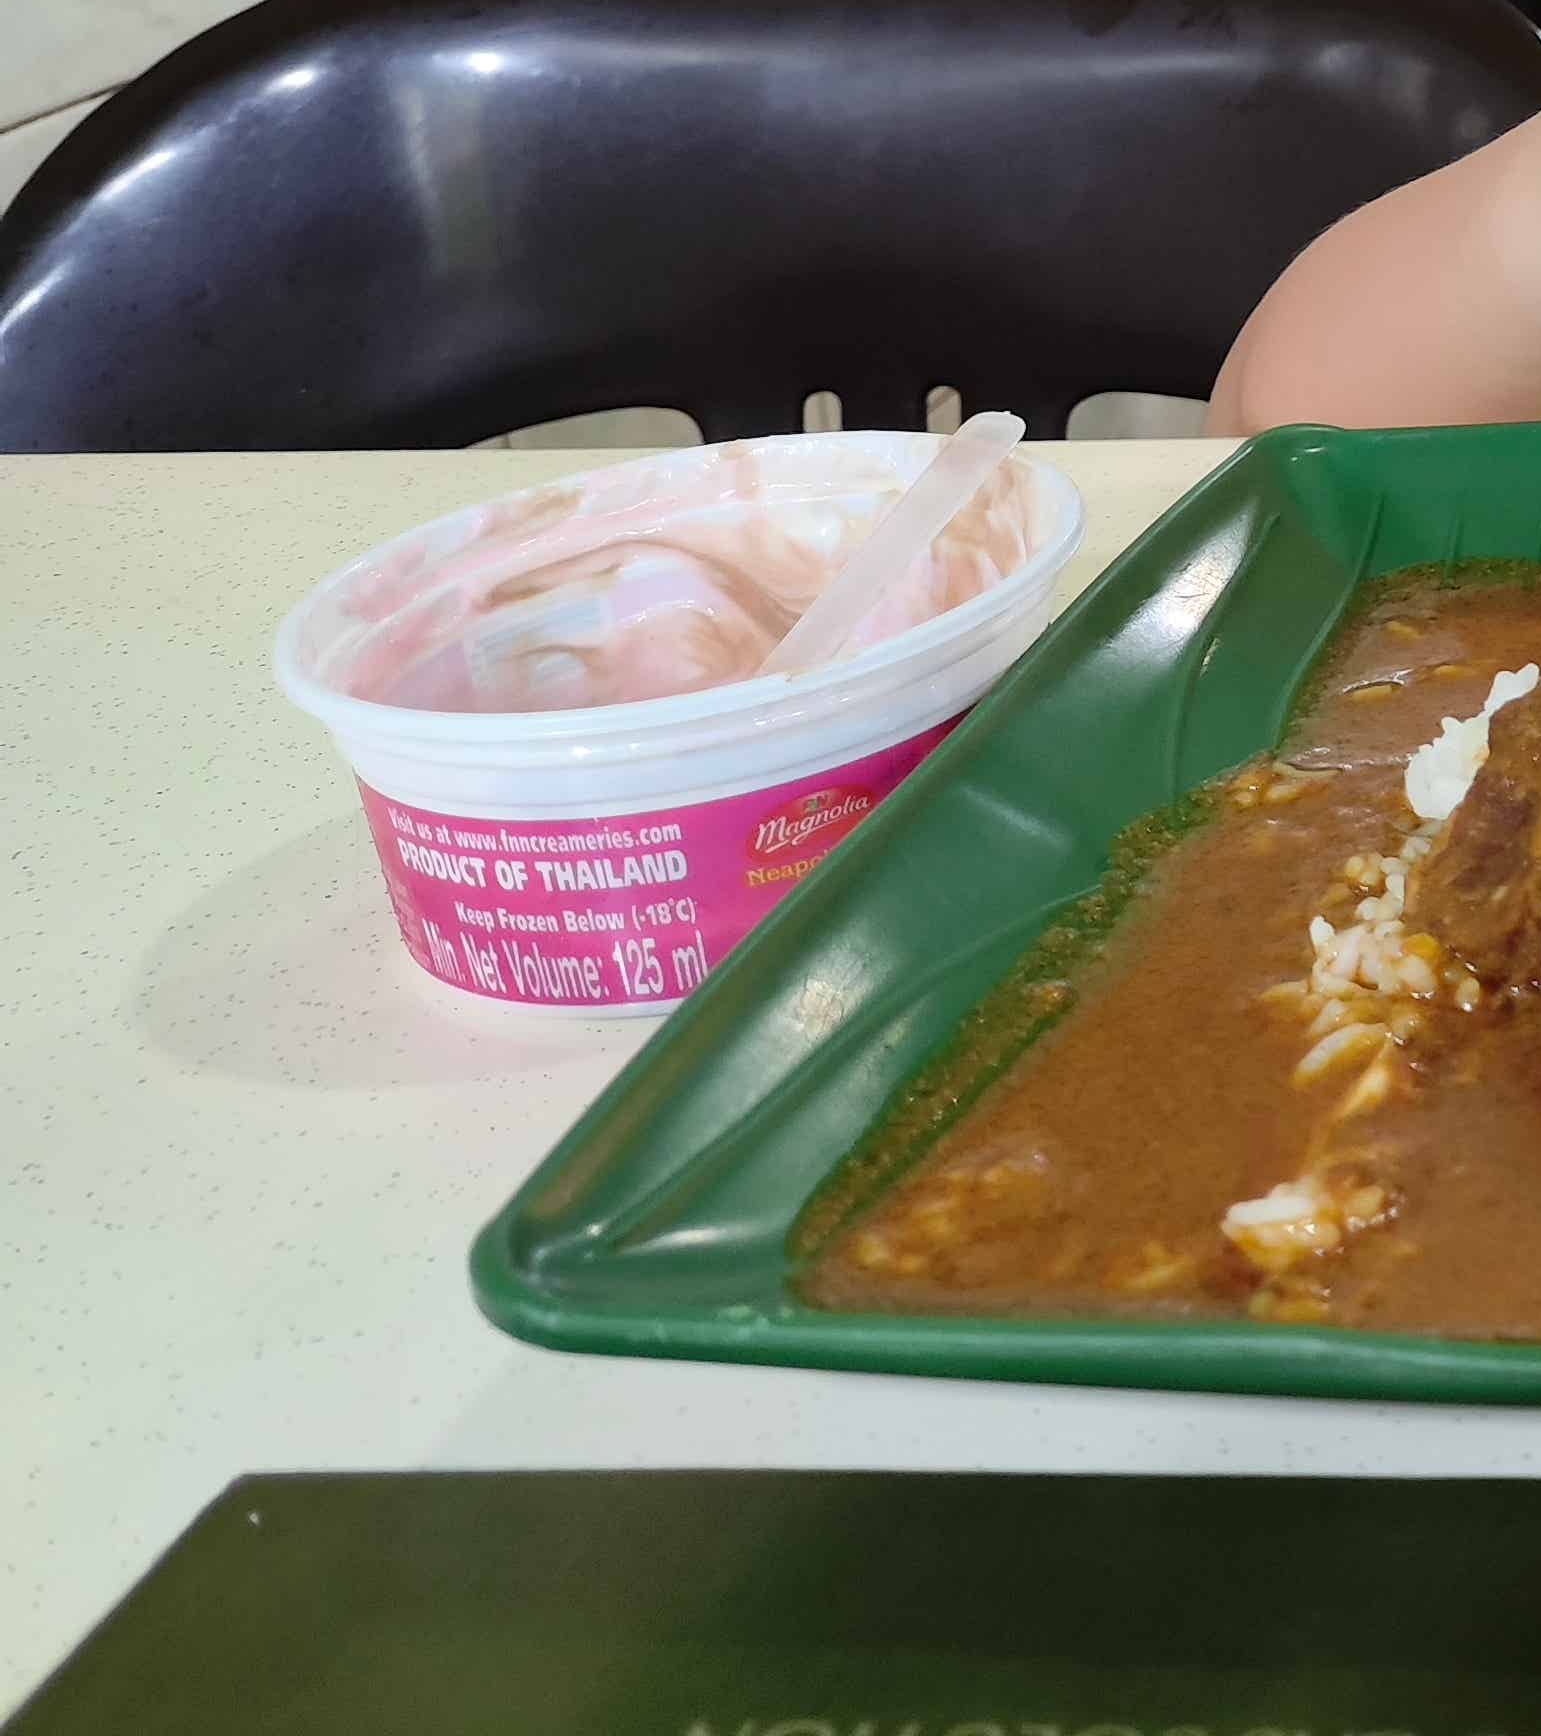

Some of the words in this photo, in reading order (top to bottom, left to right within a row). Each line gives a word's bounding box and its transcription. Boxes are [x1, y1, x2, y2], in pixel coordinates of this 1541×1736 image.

[388, 807, 416, 836] Visit
[416, 822, 433, 841] us
[436, 824, 452, 845] at
[453, 824, 682, 853] www.fnncreameries.com
[755, 795, 869, 853] Magnolia
[397, 837, 487, 888] PRODUCT
[495, 859, 529, 891] OF
[535, 850, 687, 892] THAILAND
[455, 900, 495, 933] Keep
[496, 907, 559, 933] Frozen
[562, 908, 625, 933] Below
[461, 931, 507, 994] Net
[502, 939, 609, 999] Volume:
[612, 937, 664, 997] 125
[671, 929, 708, 992] ml
